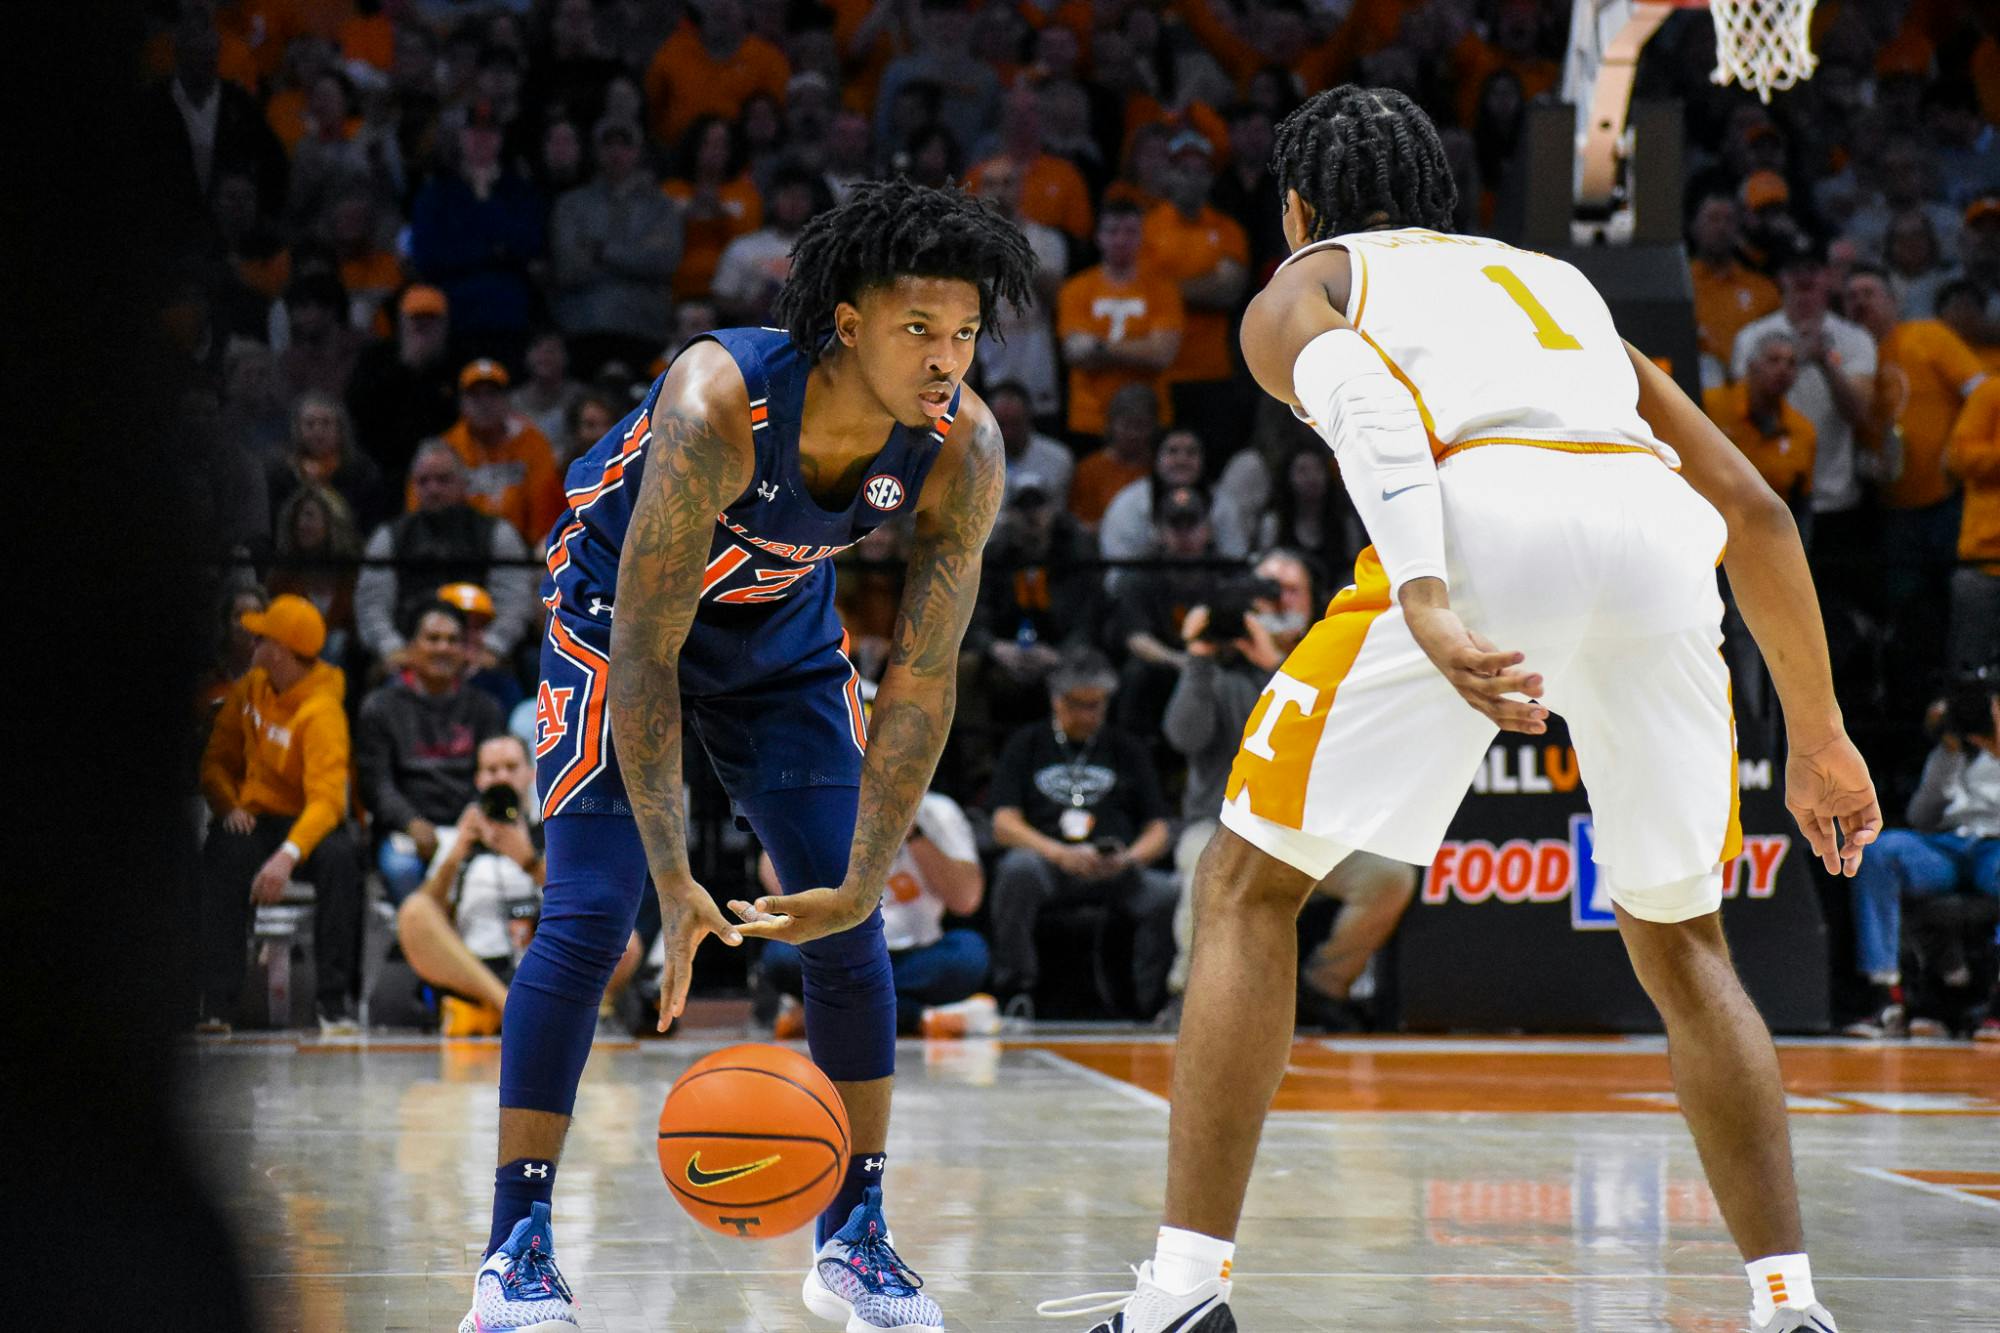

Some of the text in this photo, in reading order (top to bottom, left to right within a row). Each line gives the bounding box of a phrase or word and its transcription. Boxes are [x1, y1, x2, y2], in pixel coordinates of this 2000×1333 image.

[1092, 298, 1147, 342] T
[1481, 265, 1584, 350] 1
[867, 477, 901, 508] SEC
[1243, 669, 1320, 762] T
[1424, 839, 1574, 903] FOOD
[718, 1215, 761, 1237] T
